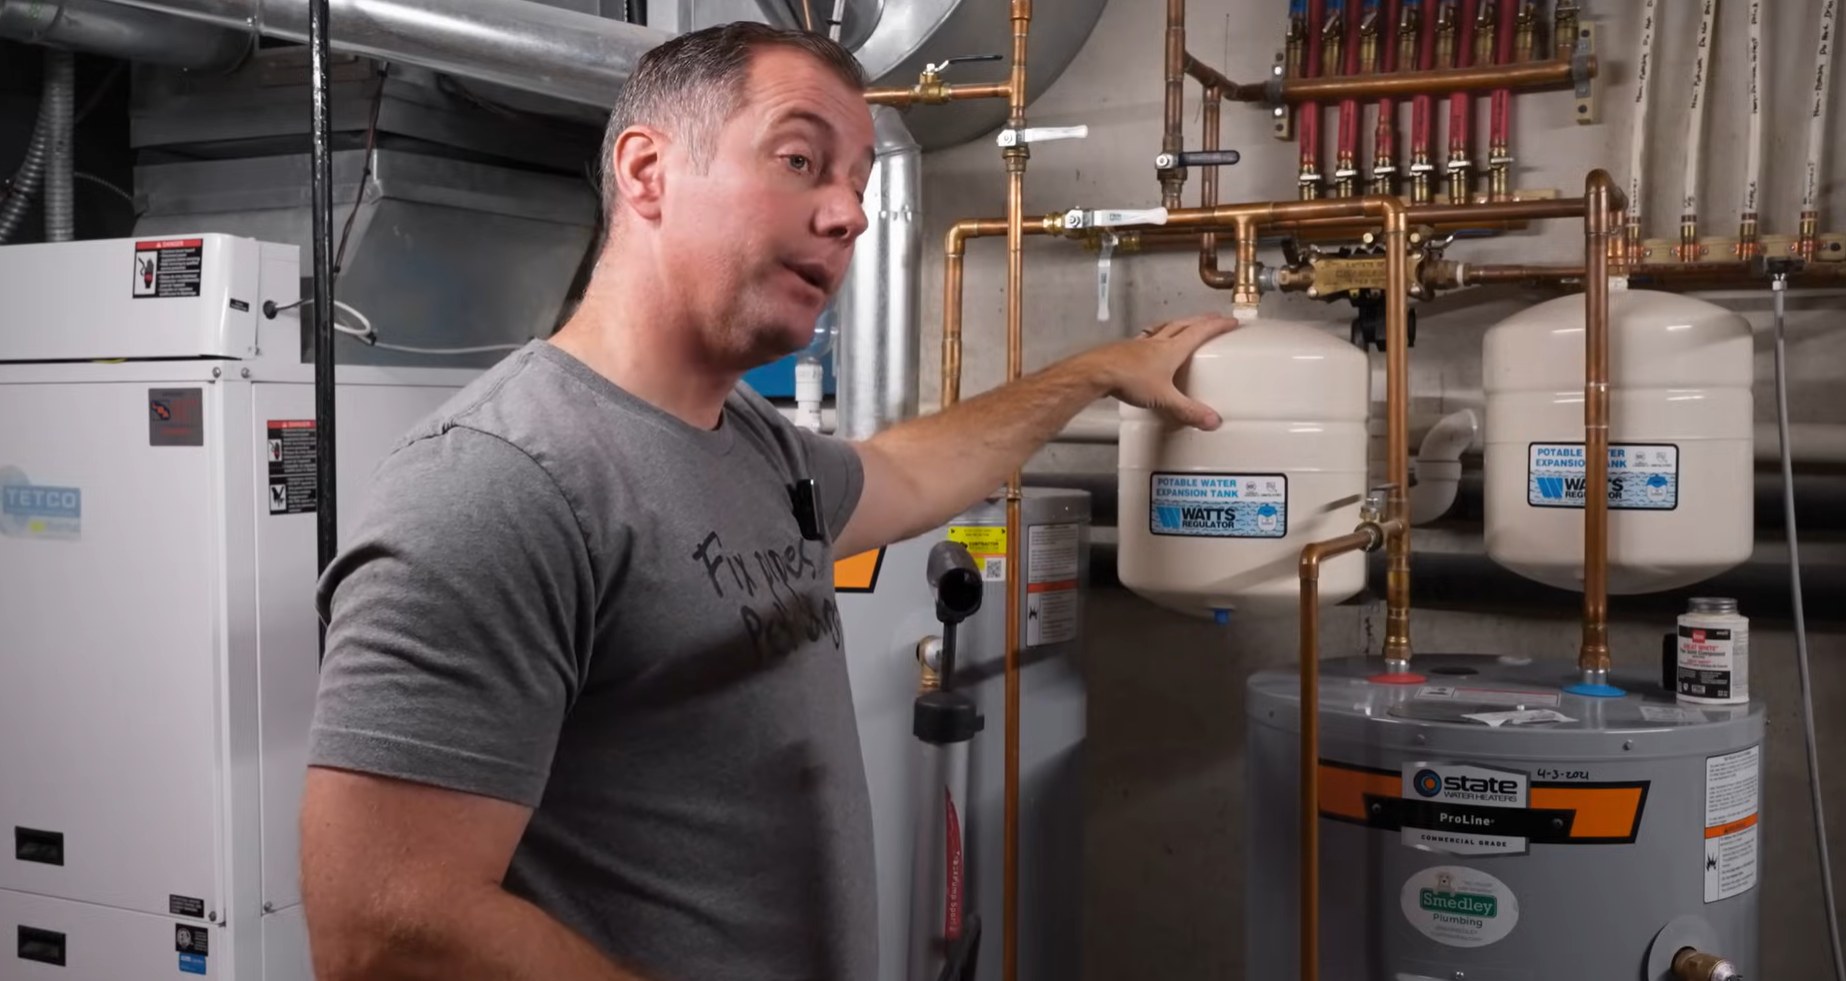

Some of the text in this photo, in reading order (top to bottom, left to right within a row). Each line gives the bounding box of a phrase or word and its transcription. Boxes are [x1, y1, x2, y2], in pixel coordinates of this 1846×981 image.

[1537, 448, 1583, 457] POTABLE
[1535, 459, 1586, 468] EXPANSIO
[1157, 478, 1237, 488] POTABLE WATER
[6, 488, 76, 508] TETCO
[1156, 488, 1238, 498] EXPANSION TANK
[1564, 491, 1622, 499] REGOR
[1181, 507, 1236, 521] WATTS
[1181, 520, 1235, 529] REGULATOR
[692, 530, 758, 598] Fix
[1537, 768, 1590, 780] 4-3-2021
[1443, 775, 1518, 795] state
[1443, 791, 1517, 803] WATER HEATERS
[1421, 834, 1475, 846] COMMERCIAL
[1423, 892, 1493, 915] Smedley
[1432, 913, 1484, 928] Plumbing
